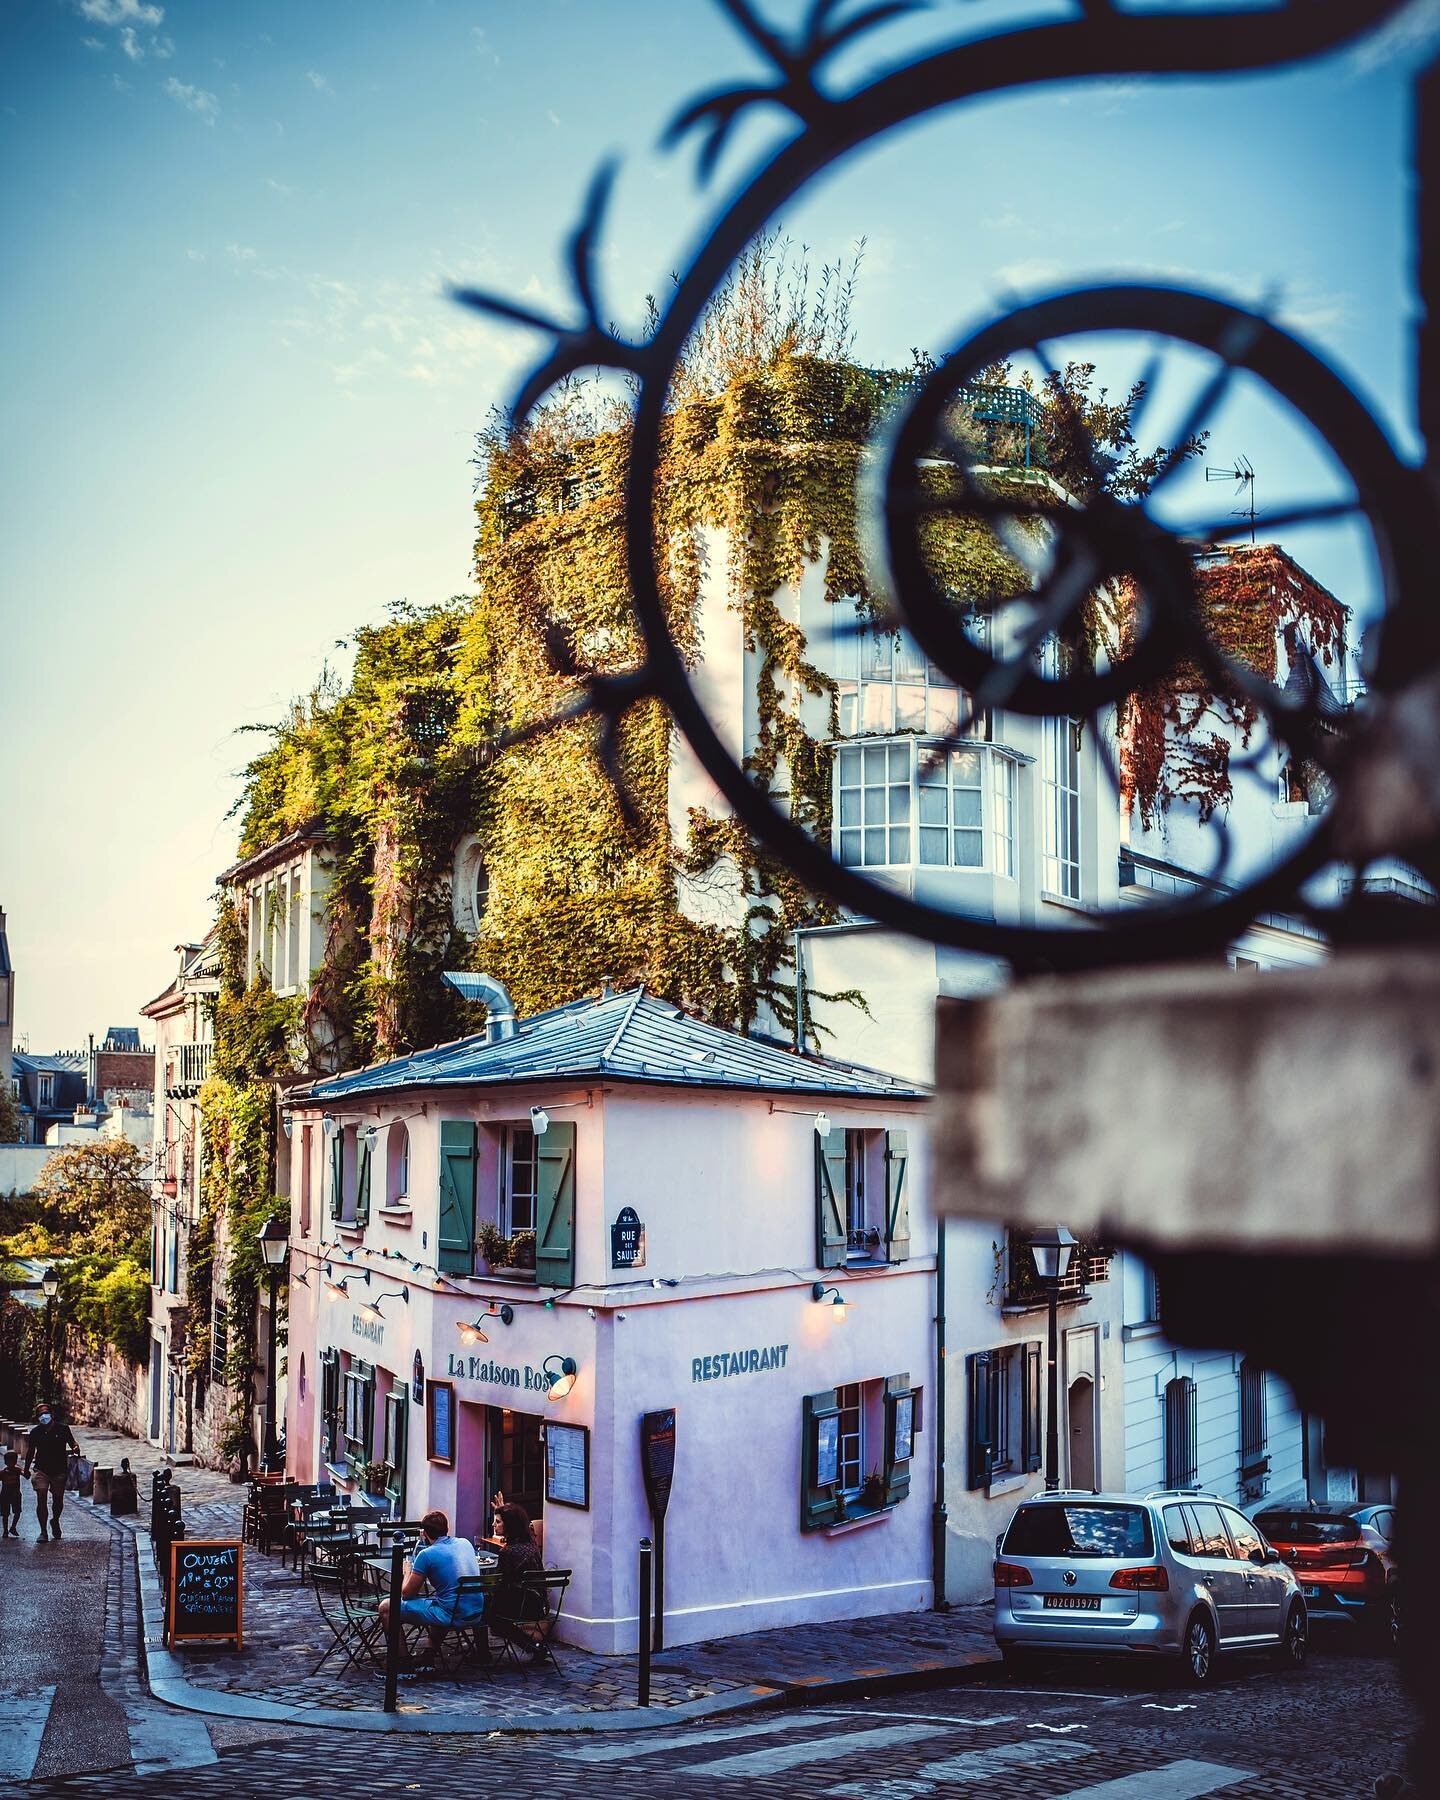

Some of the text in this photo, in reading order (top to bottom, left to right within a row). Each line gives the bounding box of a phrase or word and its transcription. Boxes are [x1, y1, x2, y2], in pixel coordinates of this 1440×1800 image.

[621, 1231, 635, 1240] RUE
[617, 1250, 641, 1260] SAULES
[448, 1353, 465, 1379] La
[468, 1356, 520, 1387] Maison
[523, 1365, 550, 1392] Ros
[692, 1344, 789, 1383] RESTAURANT
[184, 1549, 237, 1568] OUVERT
